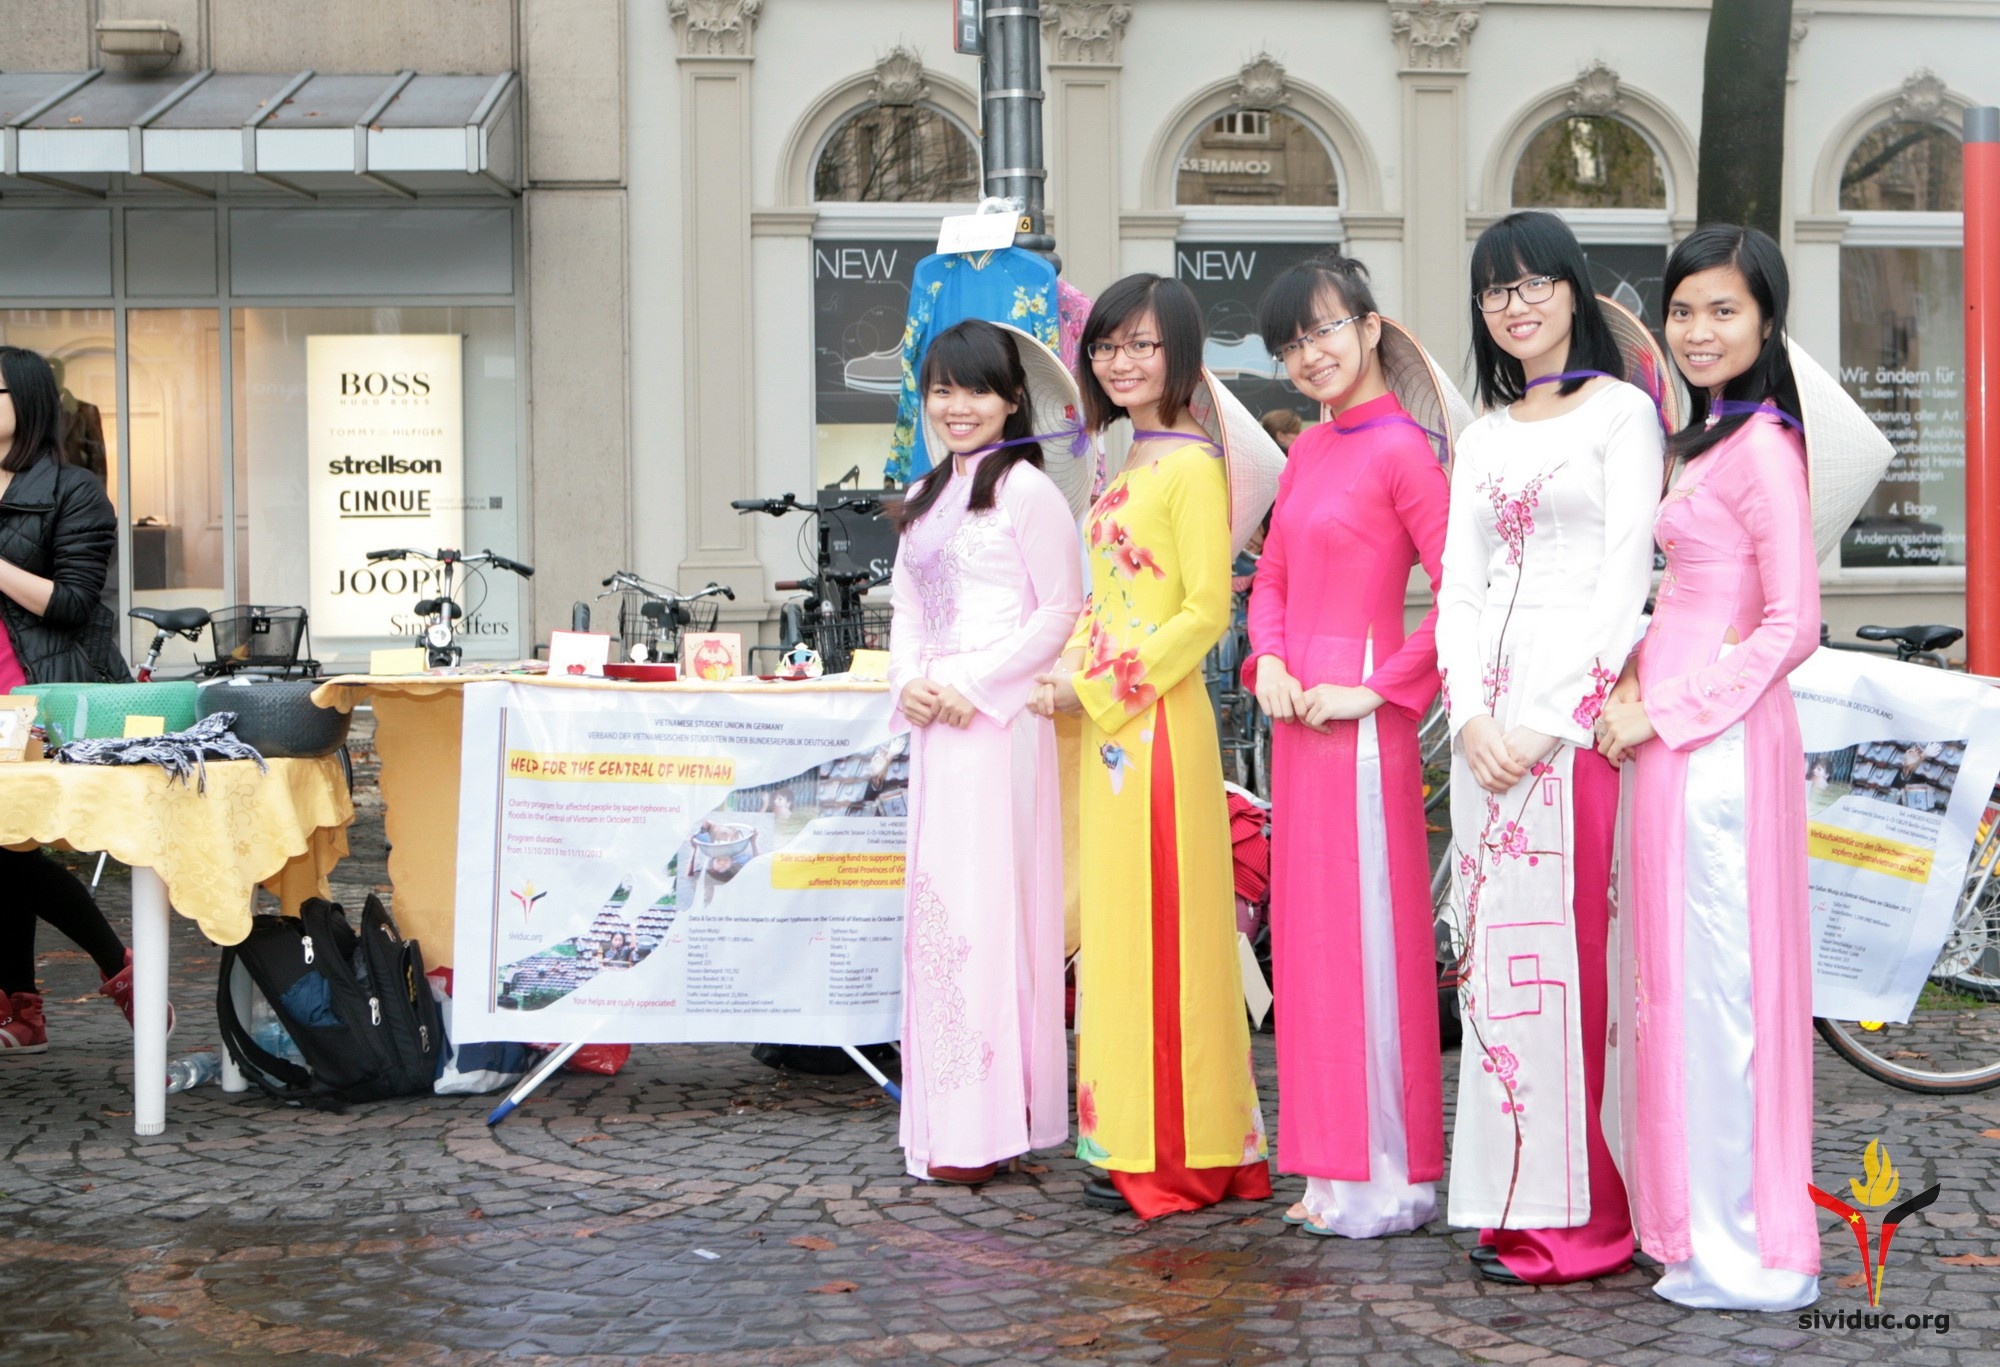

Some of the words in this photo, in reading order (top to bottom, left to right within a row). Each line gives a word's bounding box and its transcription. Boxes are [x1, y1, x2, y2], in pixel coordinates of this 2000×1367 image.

[1021, 218, 1030, 231] 6
[815, 249, 898, 279] NEW
[1177, 251, 1257, 281] NEW
[1840, 366, 1869, 384] Wir
[1876, 366, 1930, 384] ändern
[1935, 366, 1956, 384] für
[340, 371, 431, 397] BOSS
[330, 428, 375, 437] TOMMY
[393, 428, 444, 437] HILFIGER
[329, 455, 442, 475] strellson
[340, 489, 431, 512] CINQUE
[331, 568, 441, 596] JOOP!
[1801, 691, 1852, 709] BUNDESREPUBLIK
[1853, 701, 1894, 721] DEUTSCHLAND
[655, 719, 693, 728] VIETNAMESE
[695, 720, 722, 729] STUDENT
[725, 721, 744, 730] UNION
[746, 722, 752, 730] IN
[753, 721, 784, 731] GERMANY
[588, 732, 618, 740] VERBAND
[619, 732, 631, 740] DER
[690, 734, 727, 743] STUDENTEN
[736, 736, 748, 744] DER
[750, 737, 802, 747] BUNDESREPUBLIK
[804, 738, 850, 747] DEUTSCHLAND
[511, 757, 539, 773] HELP
[542, 760, 566, 775] FOR
[571, 761, 595, 776] THE
[657, 763, 674, 777] OF
[677, 764, 732, 780] VIETNAM
[509, 798, 531, 809] Charity
[532, 800, 555, 811] program
[556, 801, 564, 810] for
[566, 801, 590, 811] affected
[591, 803, 613, 813] people
[613, 803, 622, 813] by
[669, 805, 681, 813] and
[508, 811, 527, 820] floods
[535, 811, 544, 820] the
[545, 813, 565, 822] Central
[574, 814, 599, 823] Vietnam
[607, 815, 631, 824] October
[632, 815, 646, 824] 2013
[507, 833, 535, 845] Program
[847, 853, 861, 861] fund
[838, 866, 859, 874] Central
[860, 866, 888, 874] Provinces
[889, 865, 896, 873] of
[833, 878, 841, 887] by
[889, 878, 901, 886] and
[509, 932, 543, 943] sividuc.org
[574, 996, 591, 1006] Your
[617, 998, 635, 1007] really
[636, 998, 676, 1008] appreciated!
